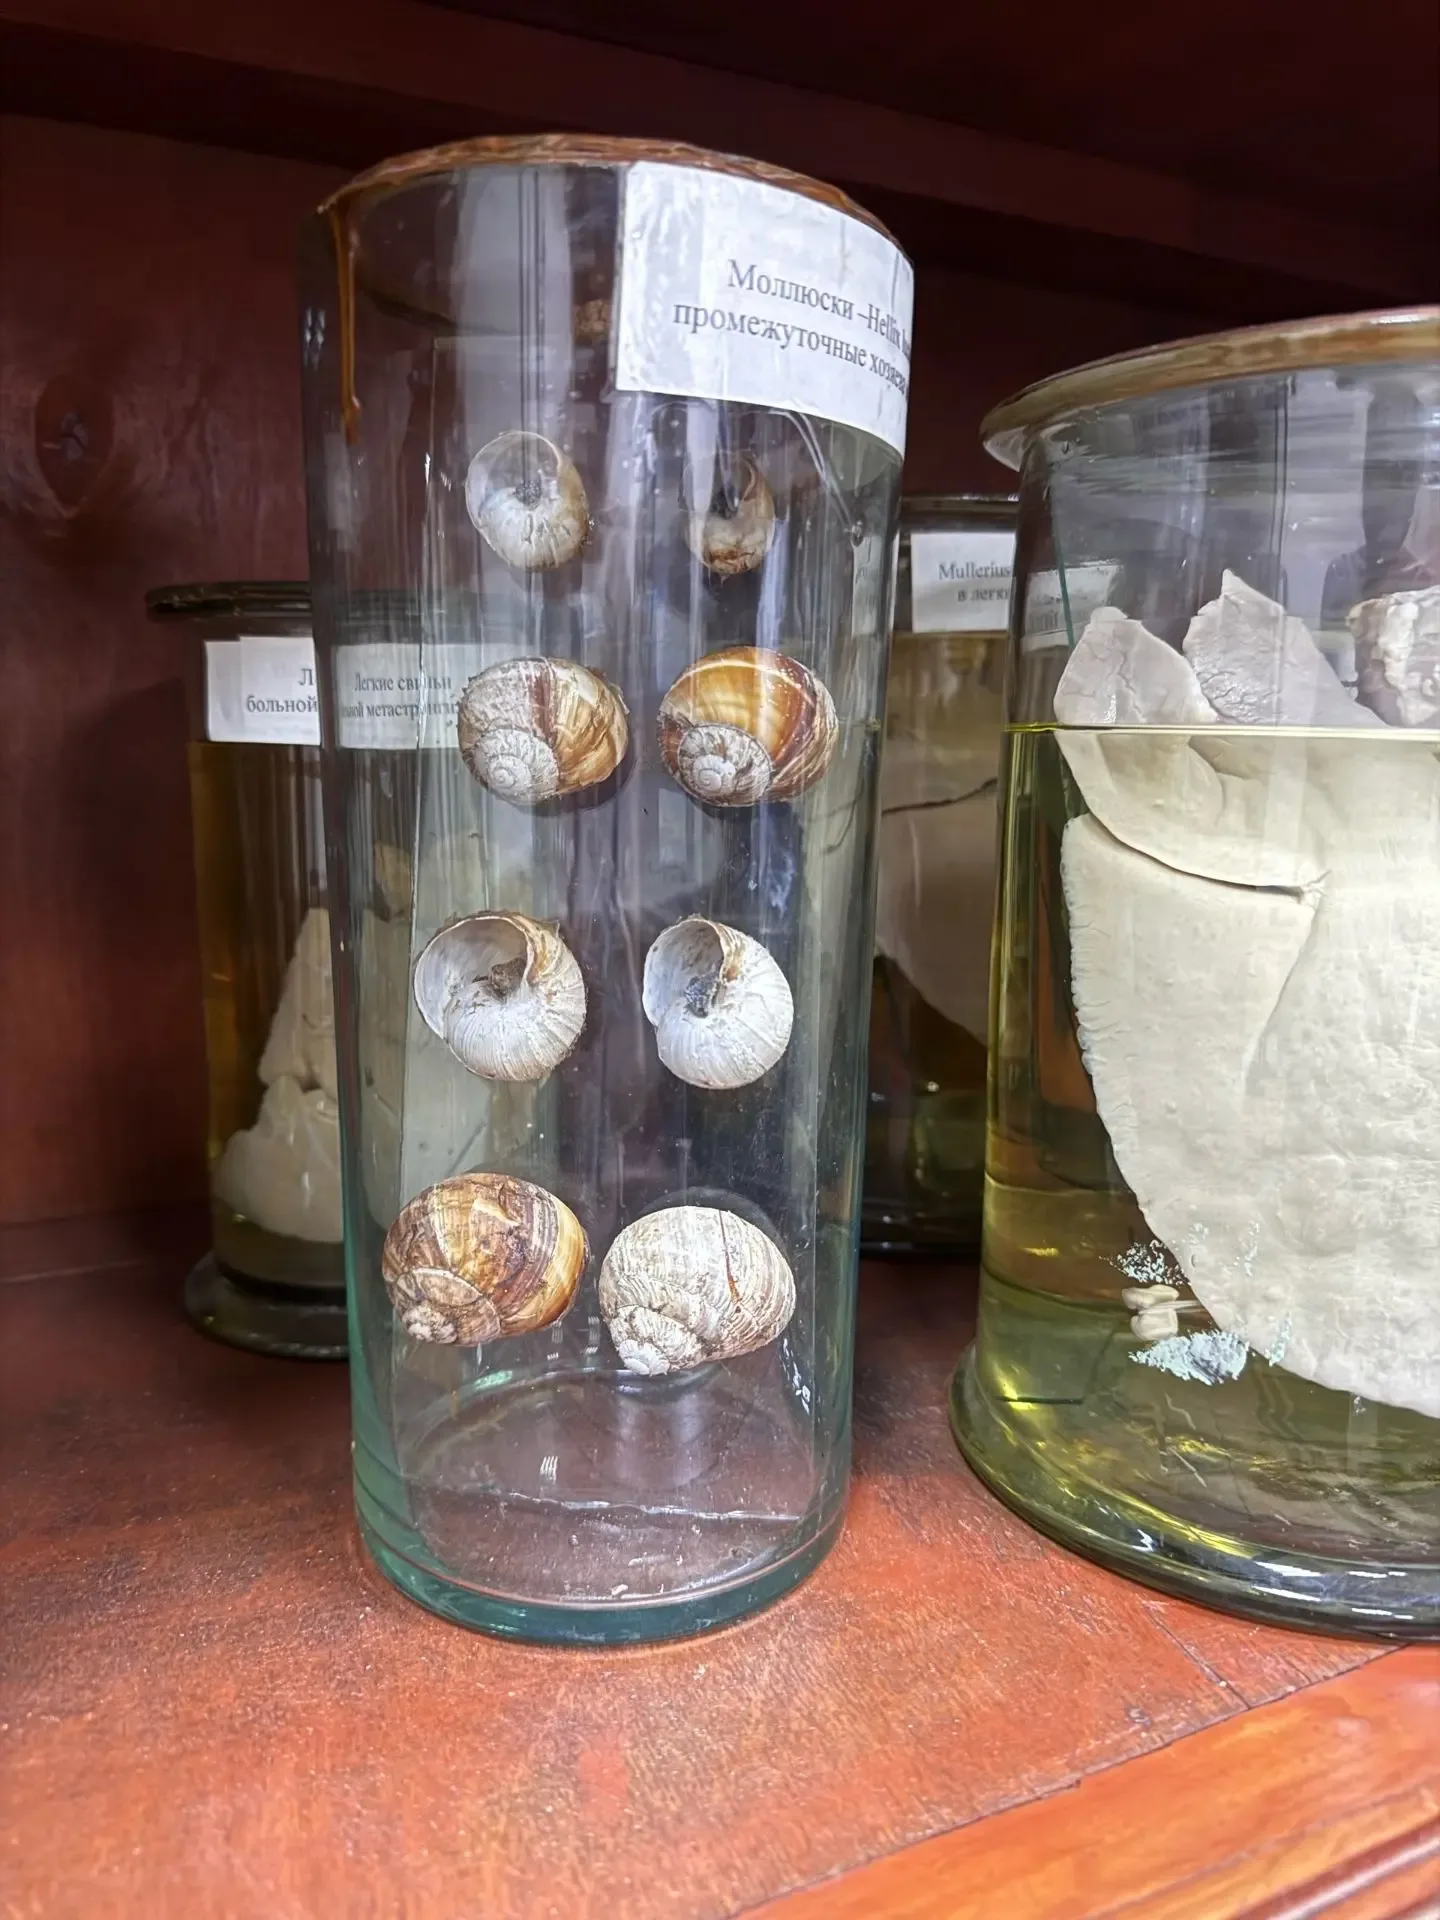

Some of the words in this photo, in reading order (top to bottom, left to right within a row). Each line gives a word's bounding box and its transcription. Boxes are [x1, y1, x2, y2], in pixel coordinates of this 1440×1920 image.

[728, 259, 853, 321] Моллюски
[673, 303, 867, 367] промежуточные
[939, 561, 1011, 580] Mullerius
[355, 672, 394, 691] Легкие
[247, 694, 318, 713] больной
